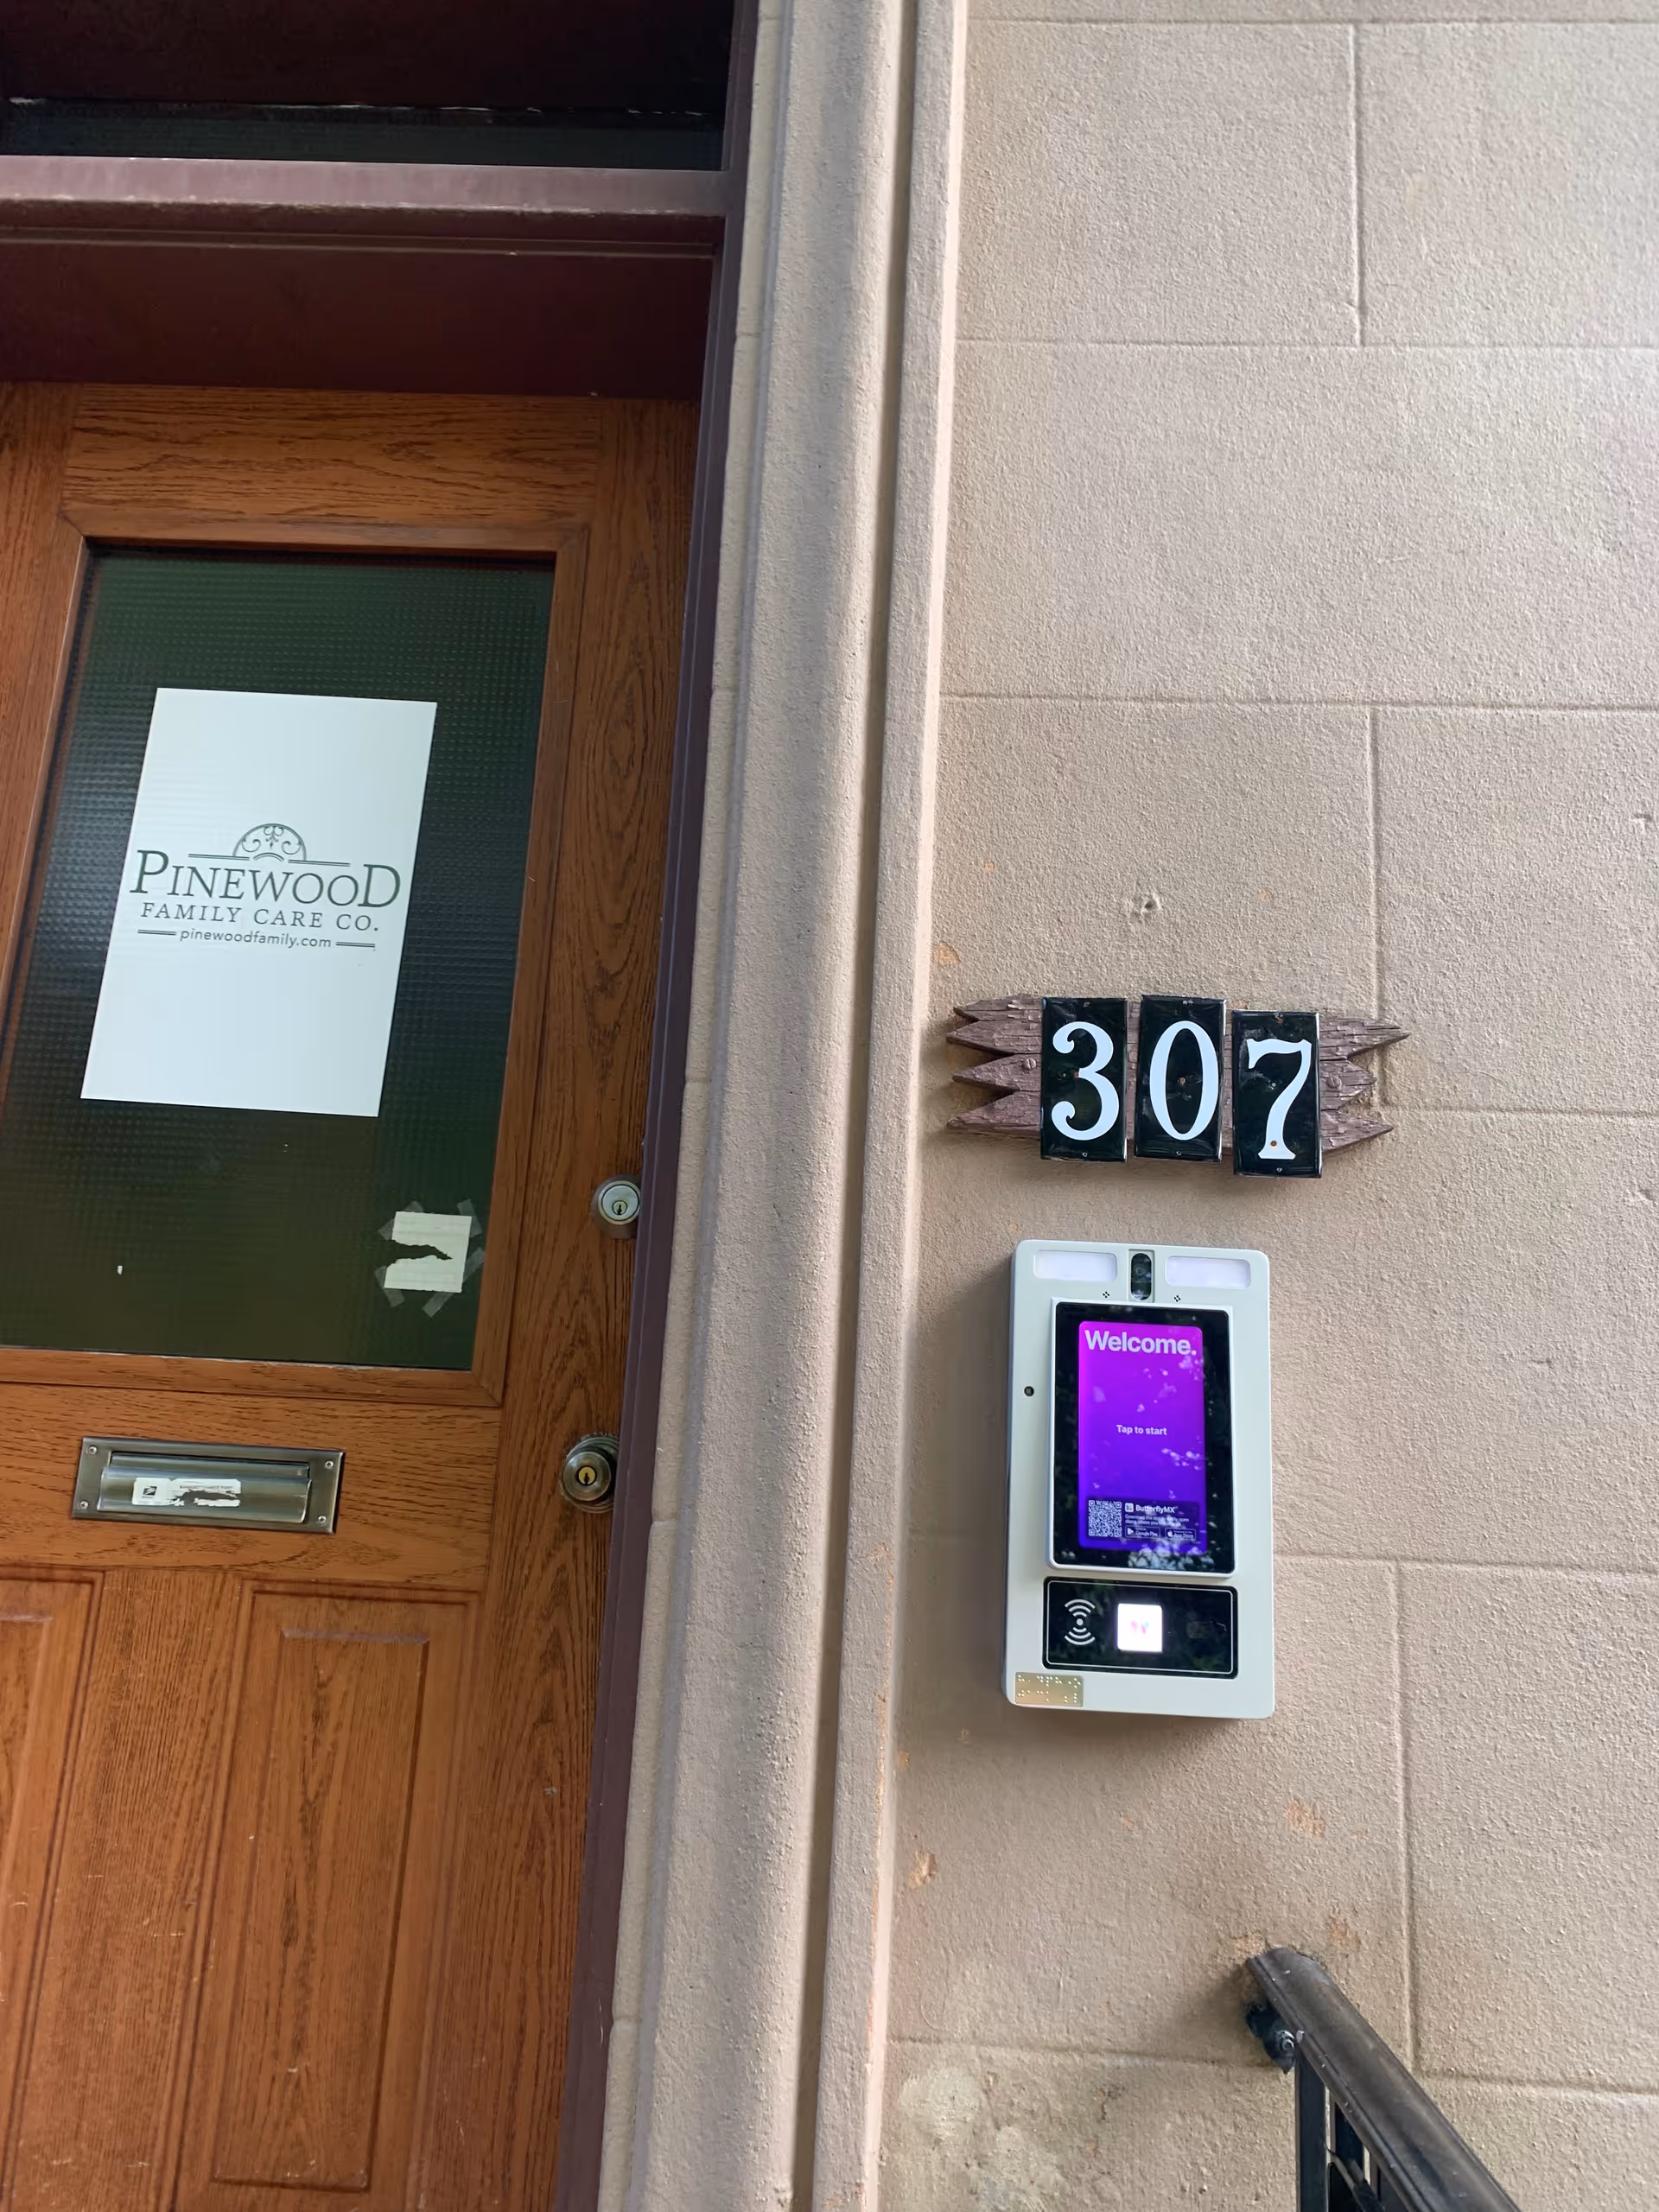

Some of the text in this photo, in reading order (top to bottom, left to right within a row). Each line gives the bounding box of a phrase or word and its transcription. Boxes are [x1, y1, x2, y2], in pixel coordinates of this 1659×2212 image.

[130, 849, 401, 908] PINEWOOD
[140, 902, 378, 931] FAMILY CARE CO.
[180, 928, 332, 949] pinewoodfamily.com
[1051, 1020, 1312, 1160] 307
[1084, 1330, 1197, 1356] Welcome.
[1116, 1424, 1167, 1435] Tap to start
[1135, 1504, 1175, 1514] ButterflyMX
